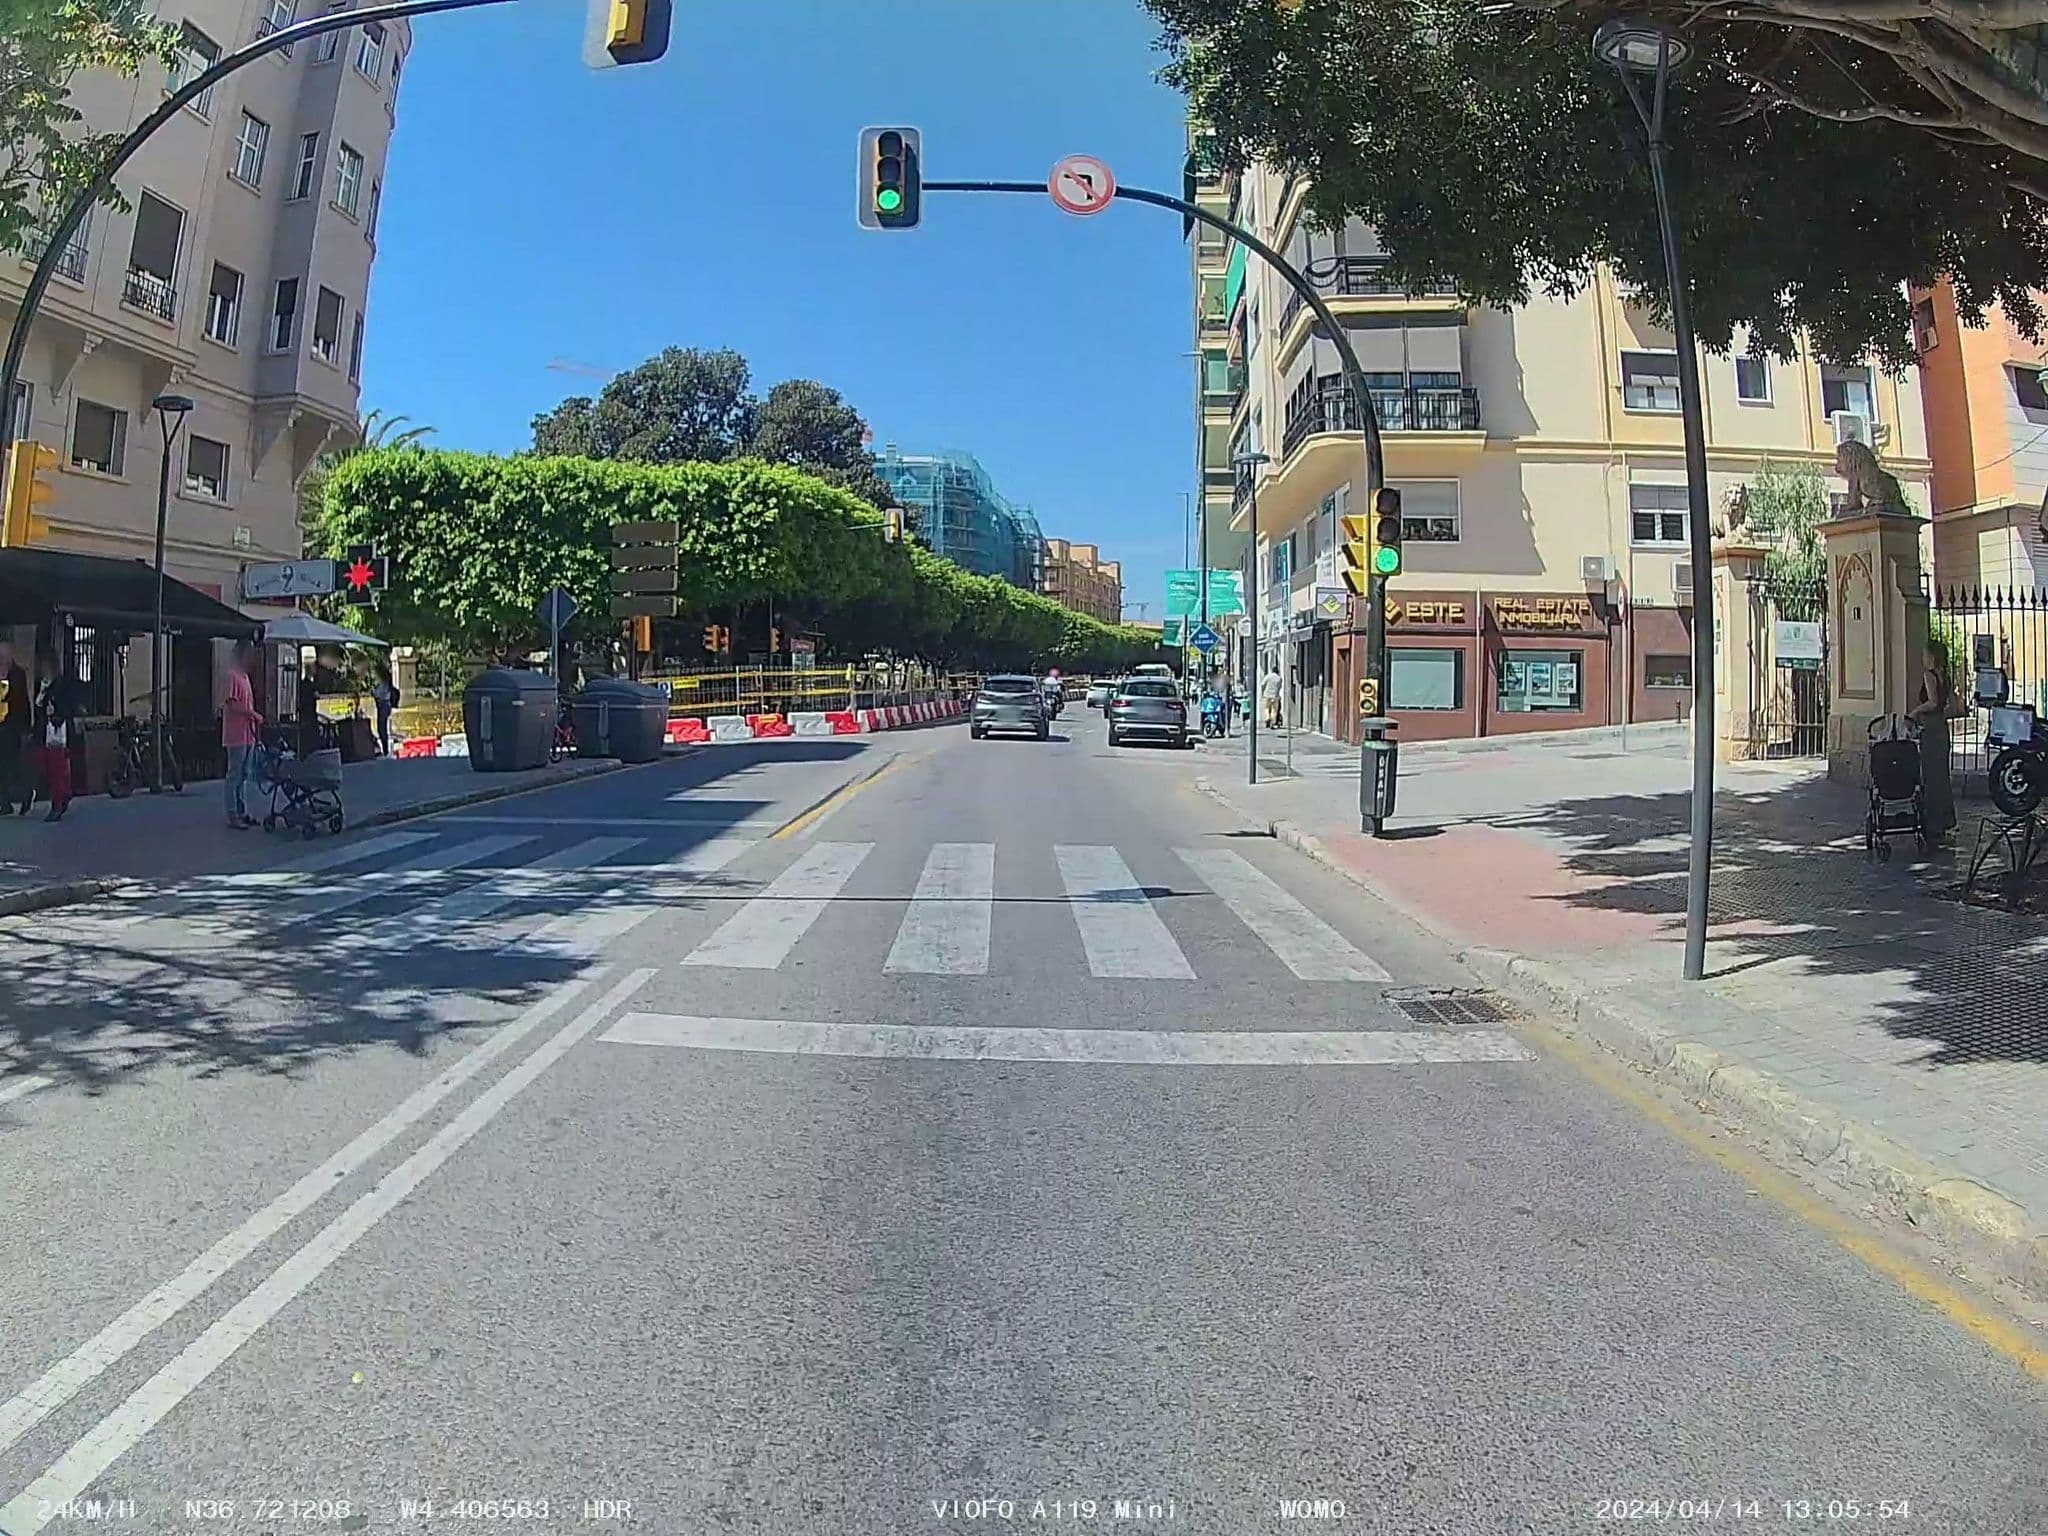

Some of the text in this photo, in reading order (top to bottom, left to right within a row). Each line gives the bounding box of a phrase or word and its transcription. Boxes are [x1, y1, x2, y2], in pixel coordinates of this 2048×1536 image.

[1406, 602, 1464, 619] ESTE
[1494, 597, 1590, 611] REAL ESTATE
[1499, 611, 1581, 625] INMOBILIARIA
